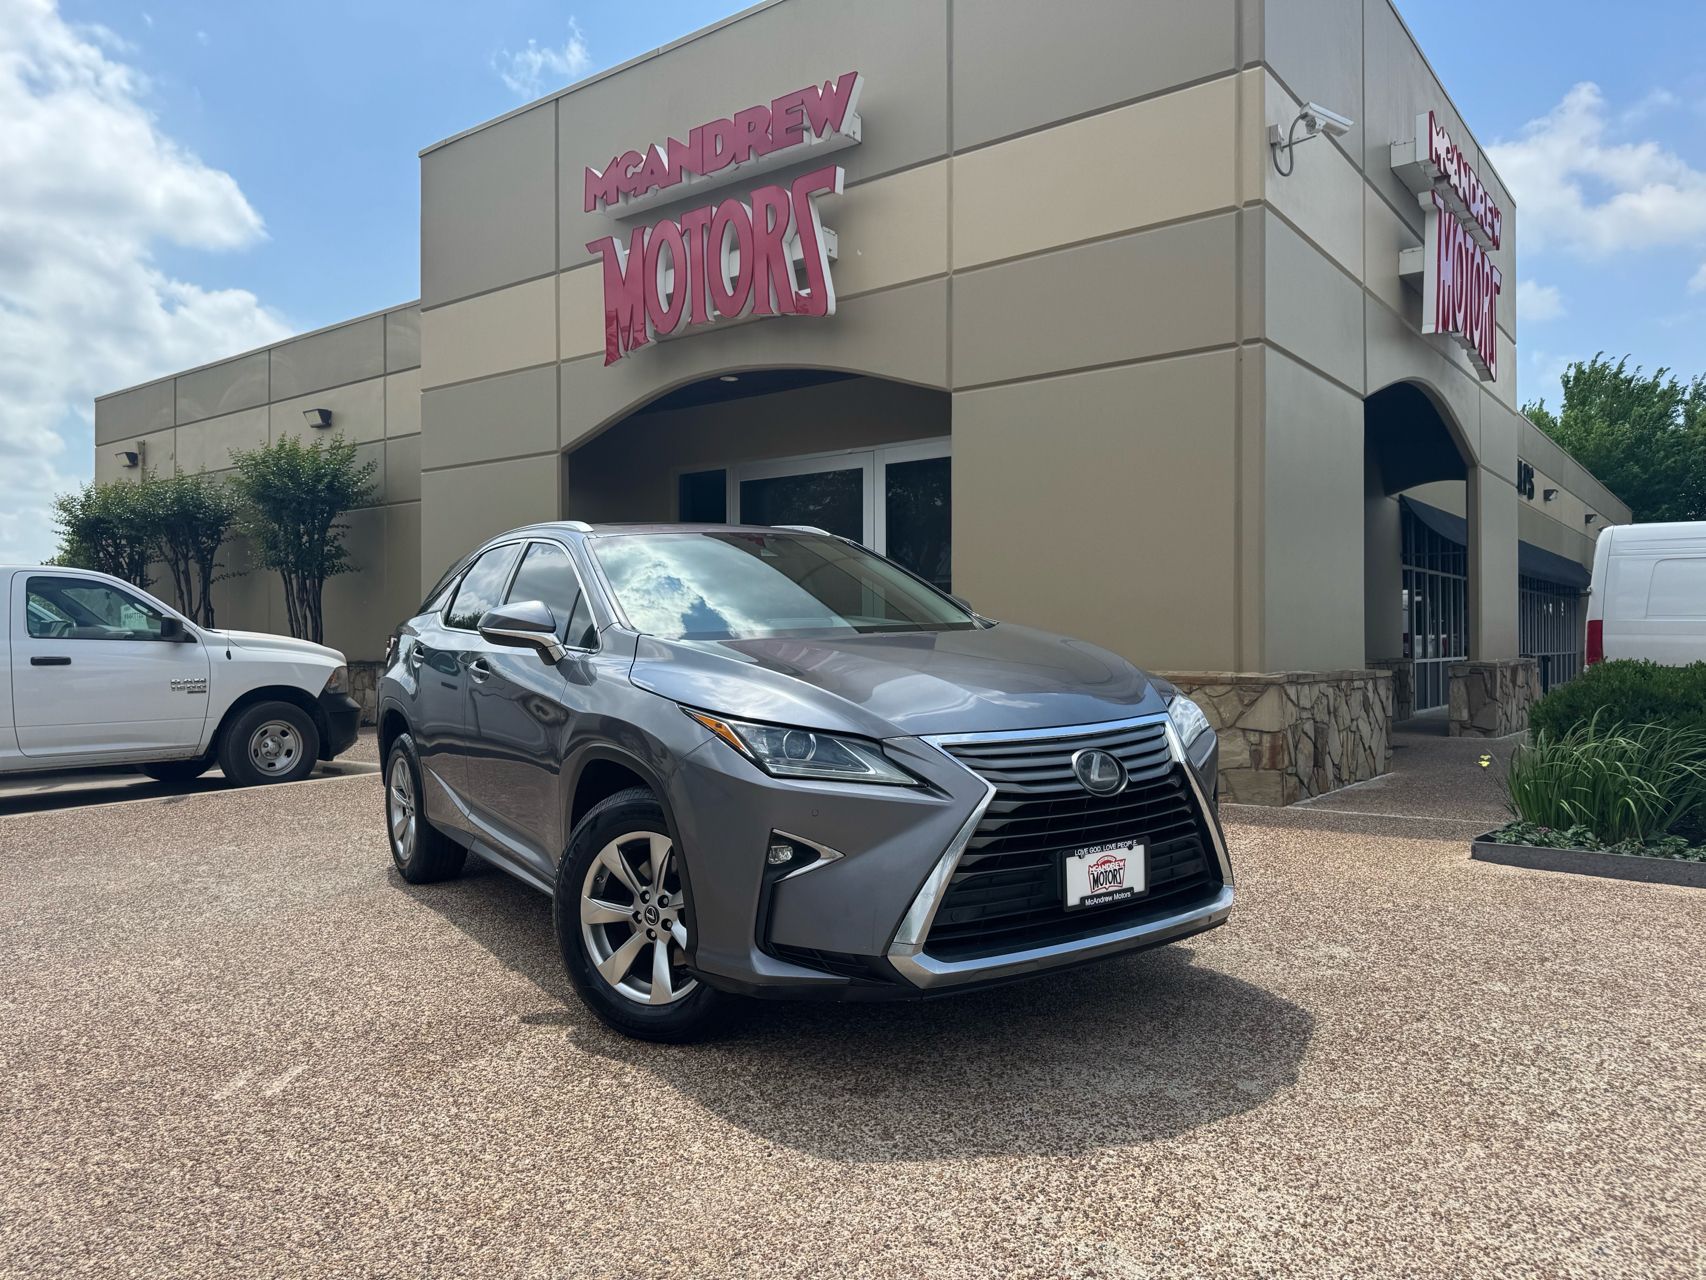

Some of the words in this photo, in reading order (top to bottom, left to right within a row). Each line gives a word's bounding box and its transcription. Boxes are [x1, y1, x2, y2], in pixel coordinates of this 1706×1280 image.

[585, 165, 840, 367] MOTORS
[1431, 189, 1502, 382] MOTORS
[1103, 842, 1117, 851] LOVE
[1091, 867, 1123, 890] MOTORS
[1085, 895, 1113, 906] McAndrew
[1113, 891, 1131, 900] Motors
